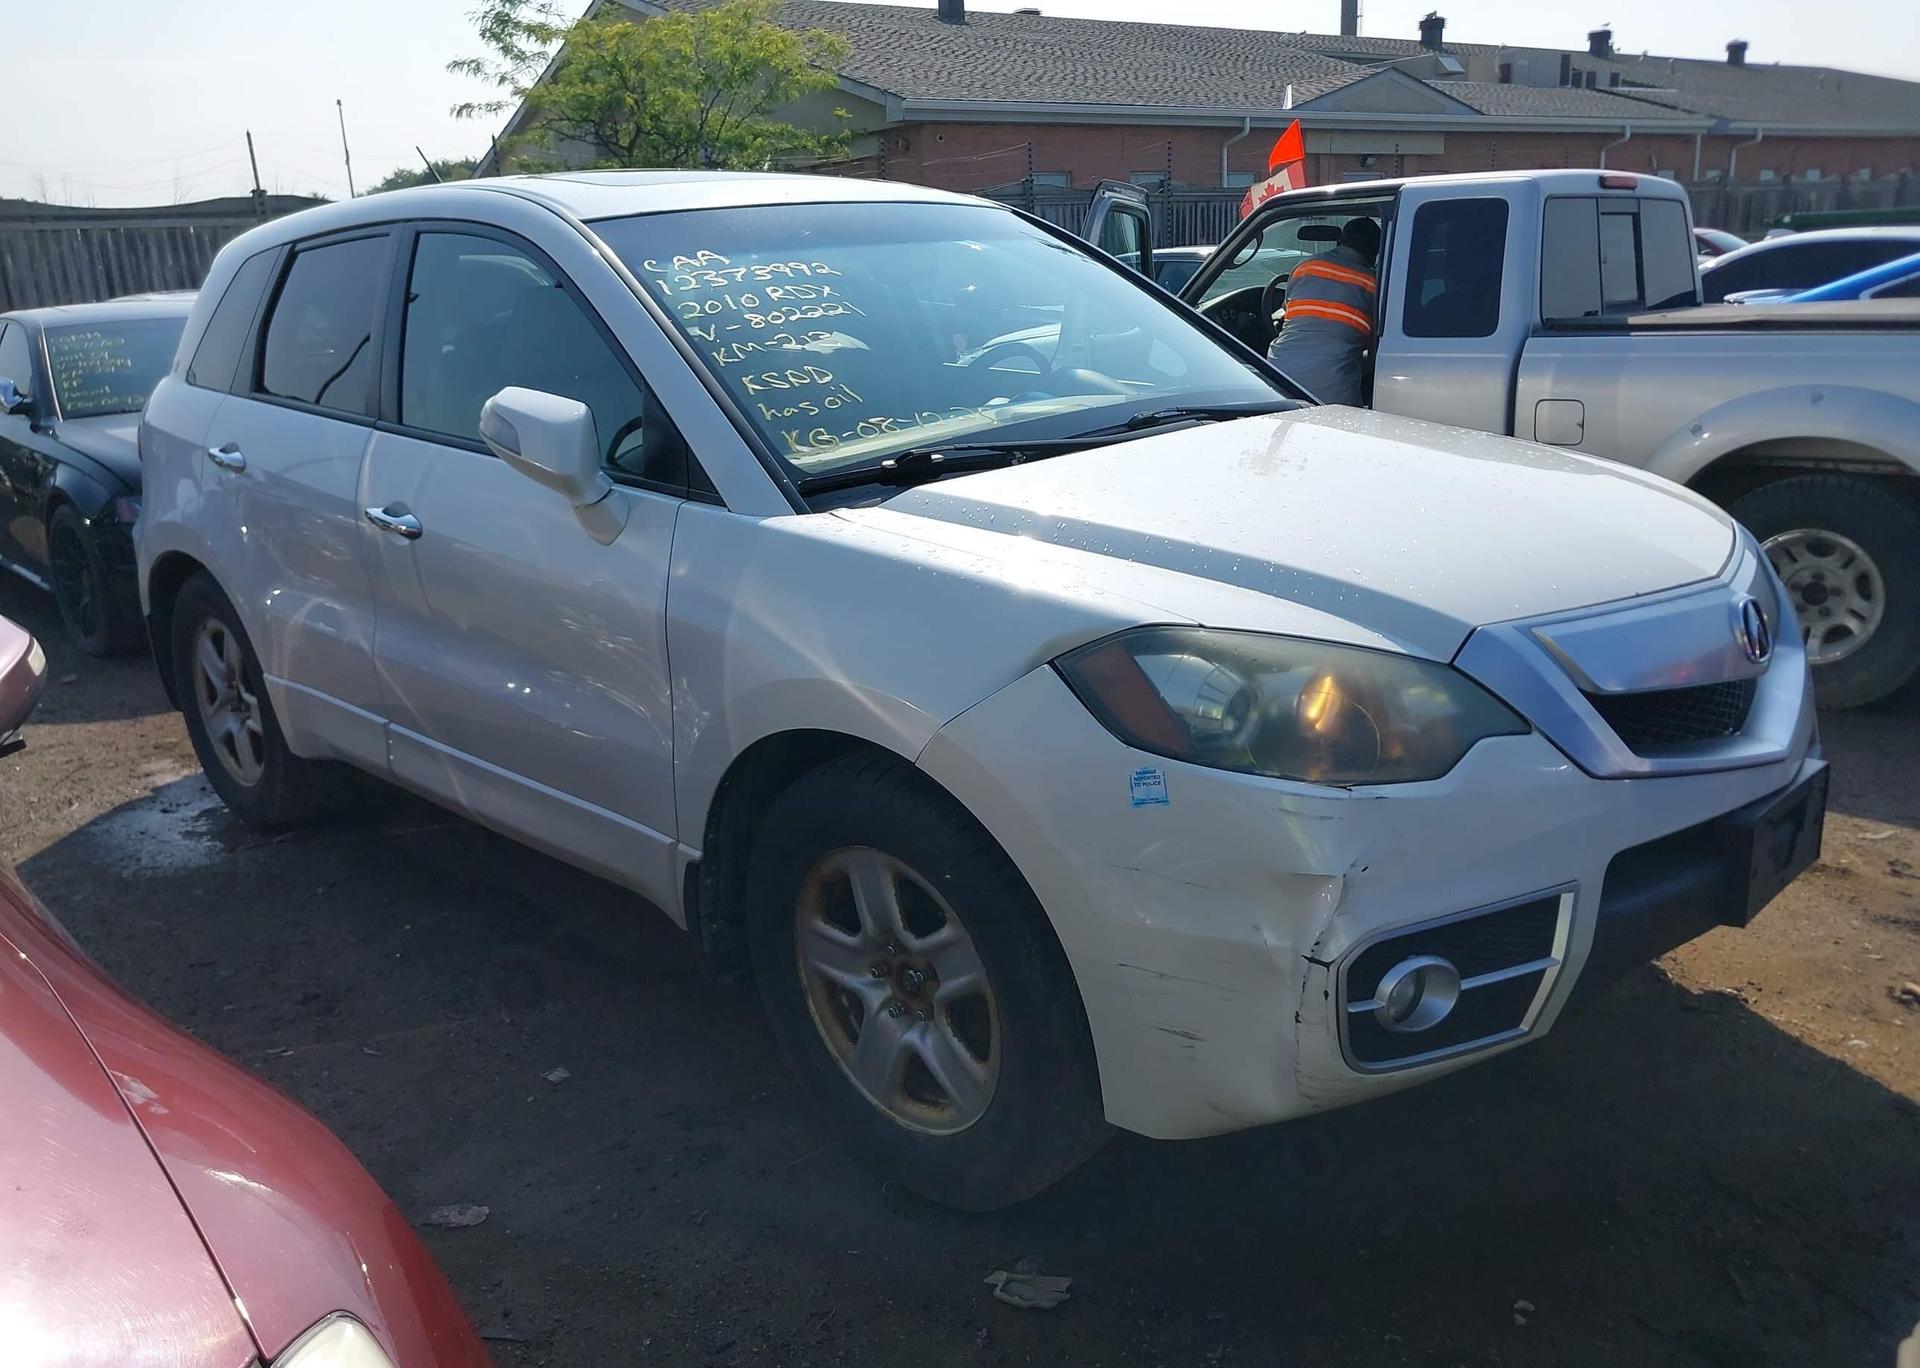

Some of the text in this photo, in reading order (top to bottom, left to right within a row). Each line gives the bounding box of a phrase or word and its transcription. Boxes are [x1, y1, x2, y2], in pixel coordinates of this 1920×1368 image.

[677, 293, 760, 319] 2010
[757, 402, 820, 421] has
[1142, 780, 1161, 788] POLICE
